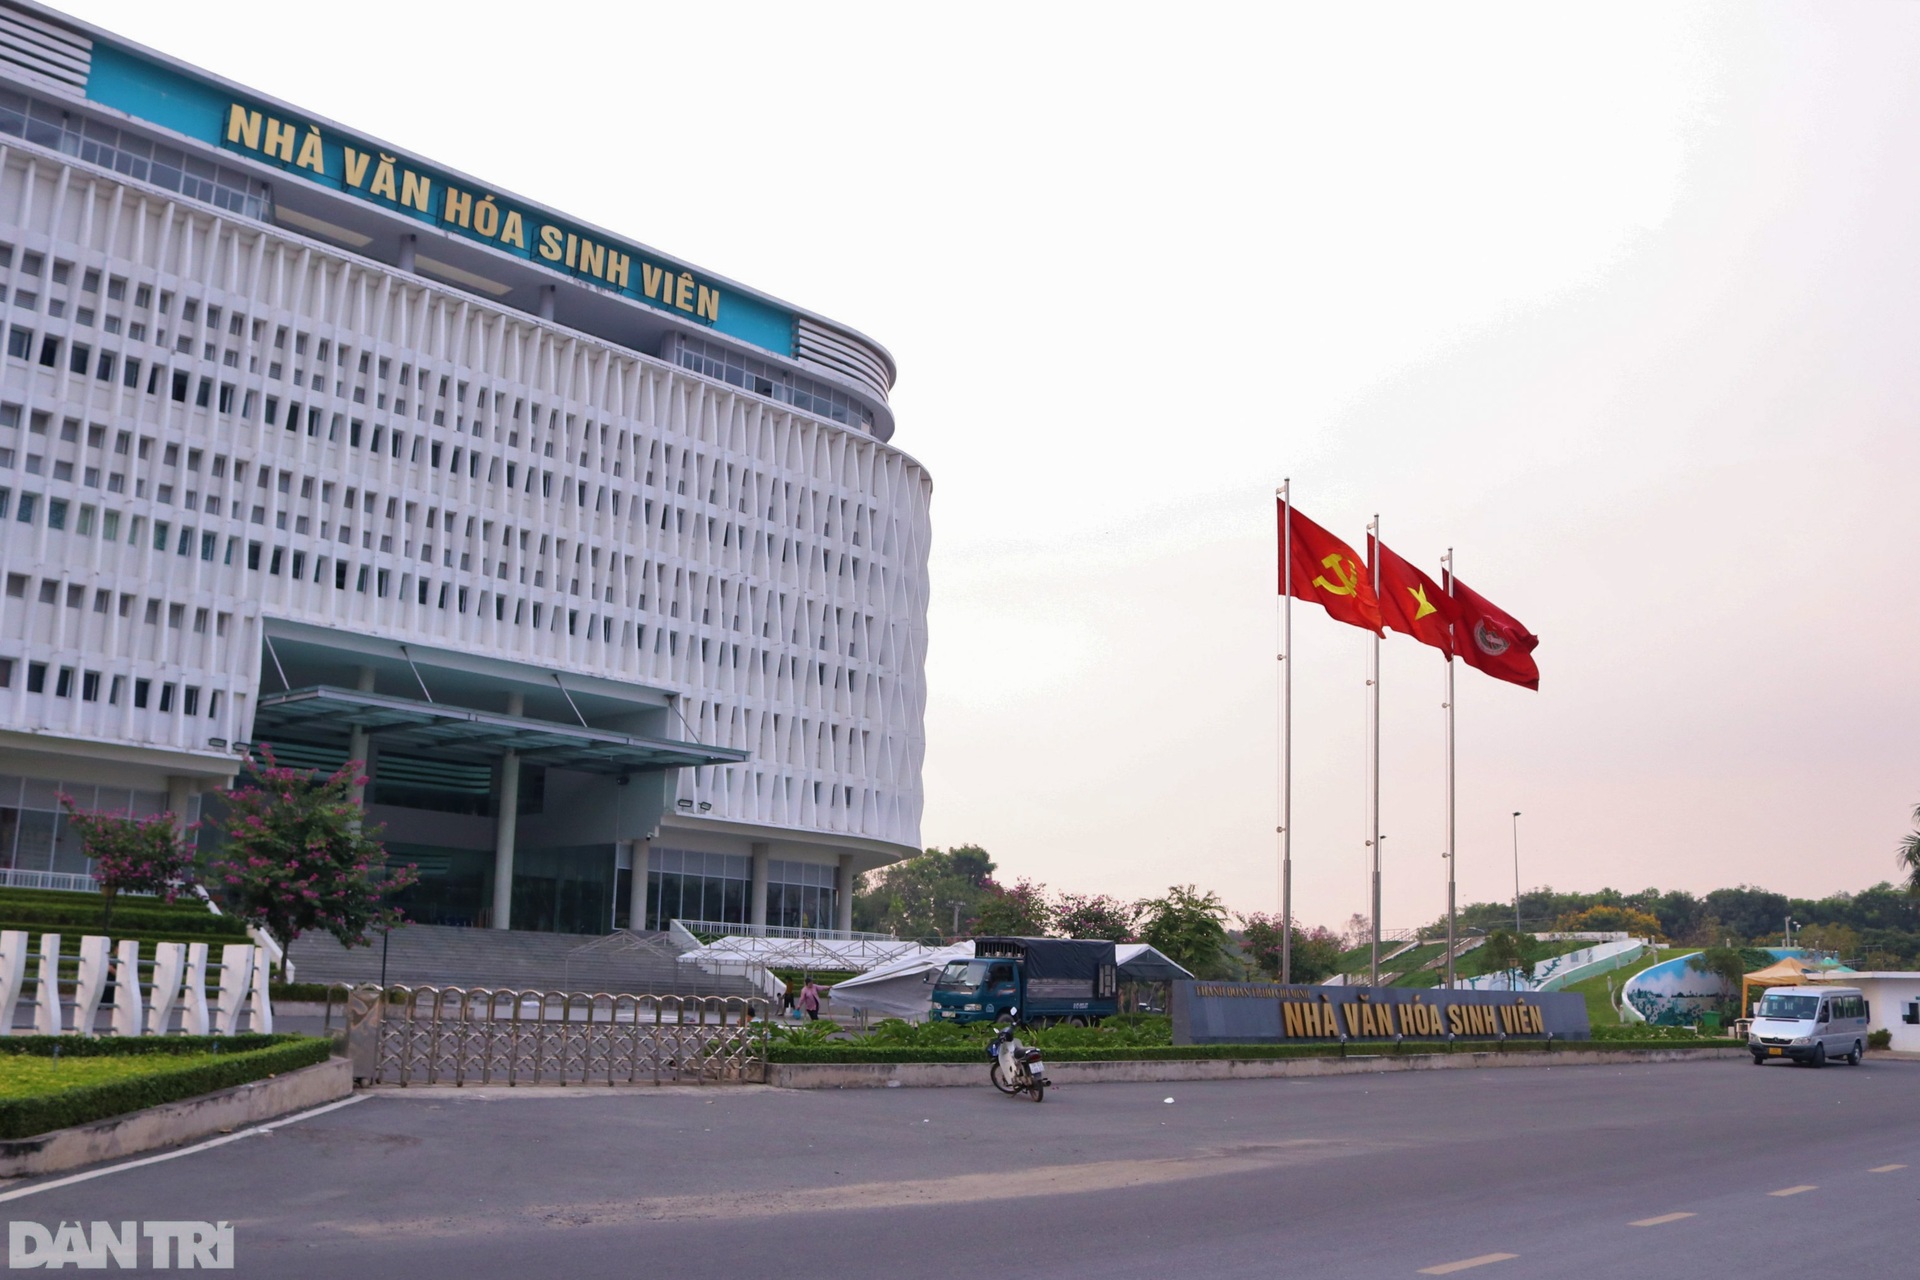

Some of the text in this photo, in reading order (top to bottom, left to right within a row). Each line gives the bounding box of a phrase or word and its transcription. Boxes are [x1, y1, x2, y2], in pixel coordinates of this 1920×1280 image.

[227, 103, 720, 322] NHÀ VĂN HÓA SINH VIÊN
[1282, 994, 1545, 1037] NHÀ VĂN HÓA SINH VIÊN
